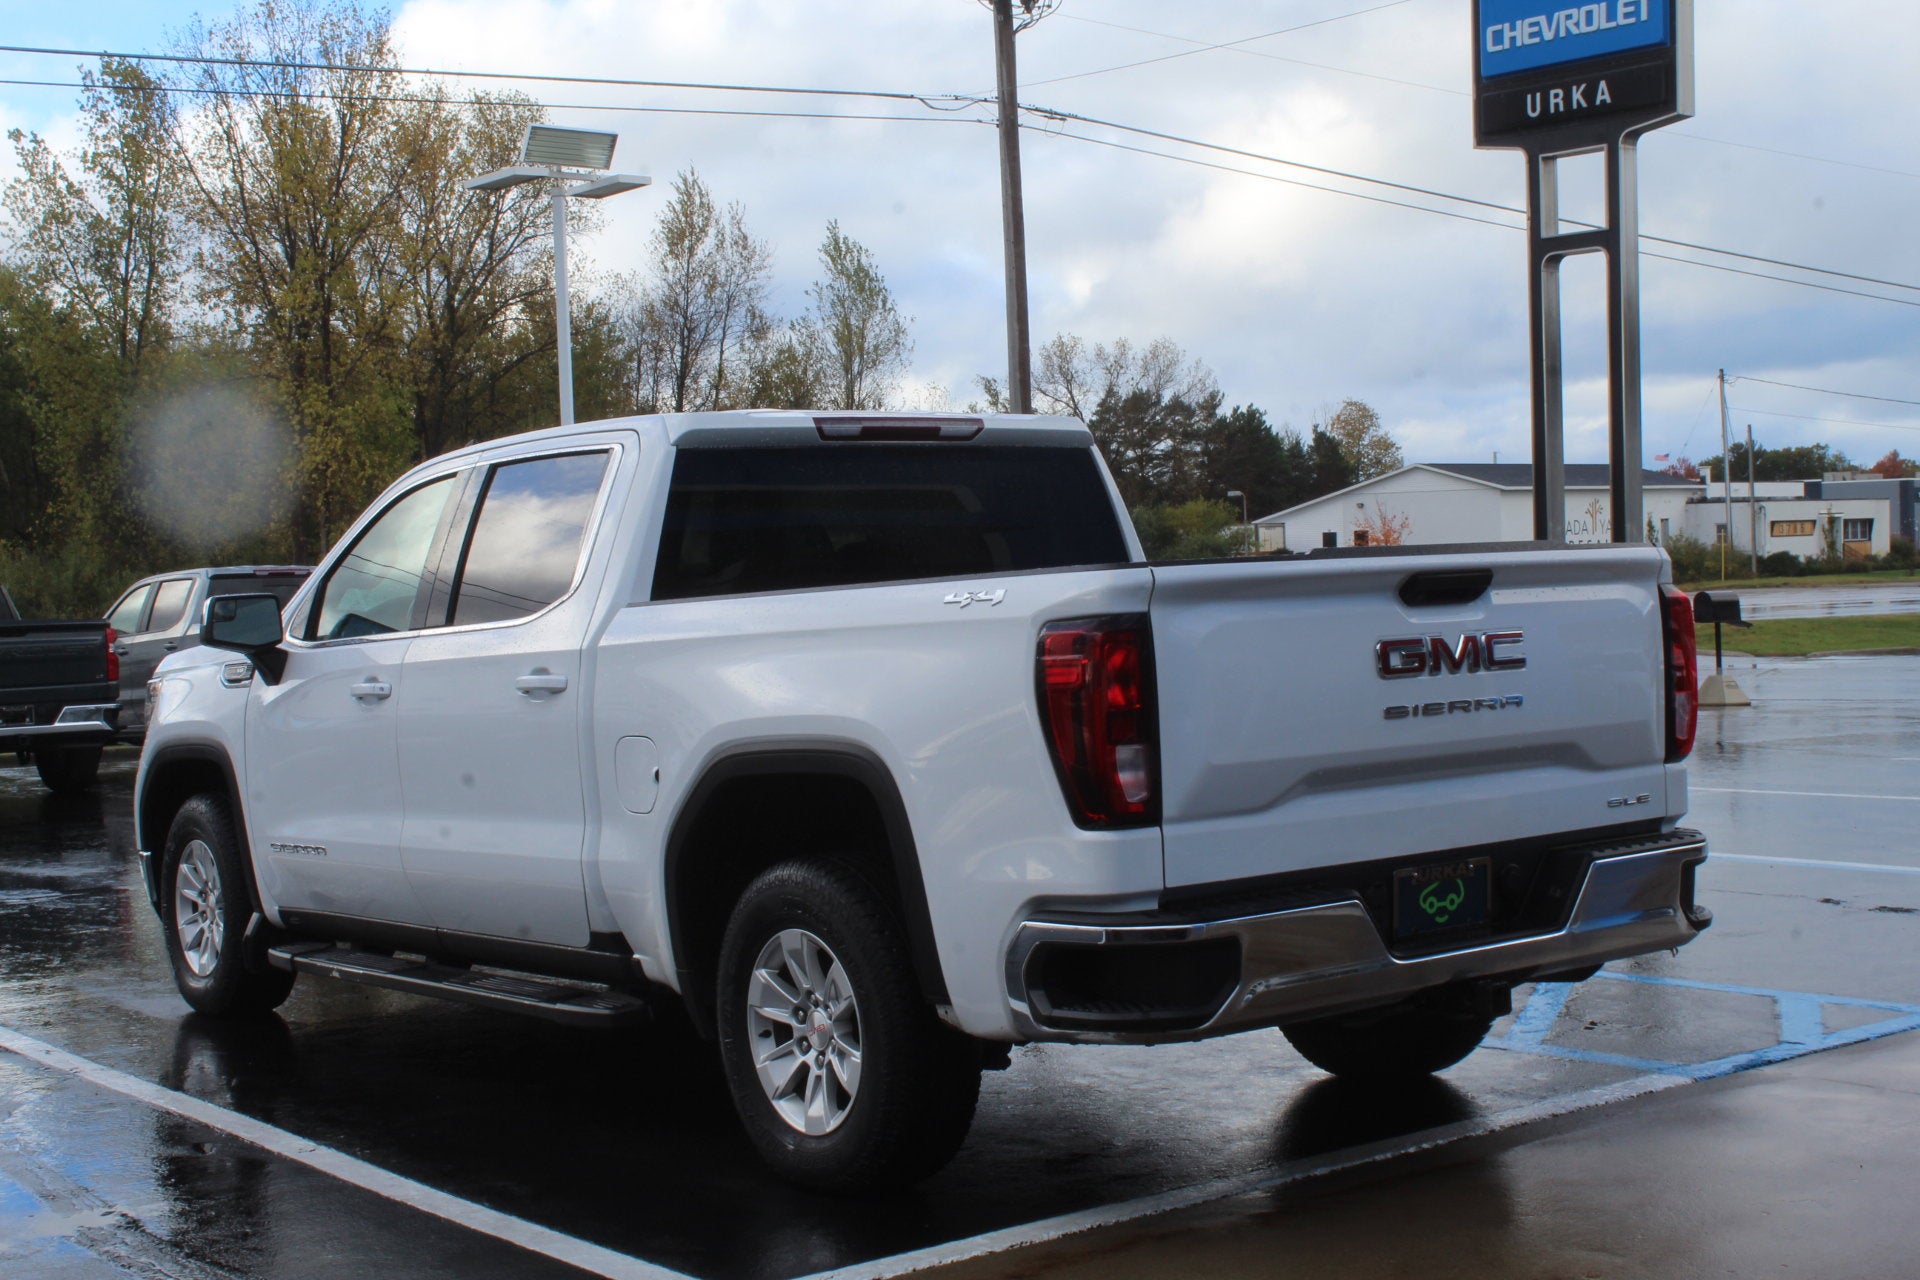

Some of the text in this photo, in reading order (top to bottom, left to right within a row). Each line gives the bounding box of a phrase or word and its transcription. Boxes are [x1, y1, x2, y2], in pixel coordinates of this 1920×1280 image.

[1486, 0, 1648, 52] CHEVROLET
[1526, 80, 1612, 118] URKA
[1375, 629, 1527, 680] GMC
[1384, 694, 1524, 720] SIERRA
[1607, 793, 1652, 808] SLE
[270, 842, 328, 856] SIERRA
